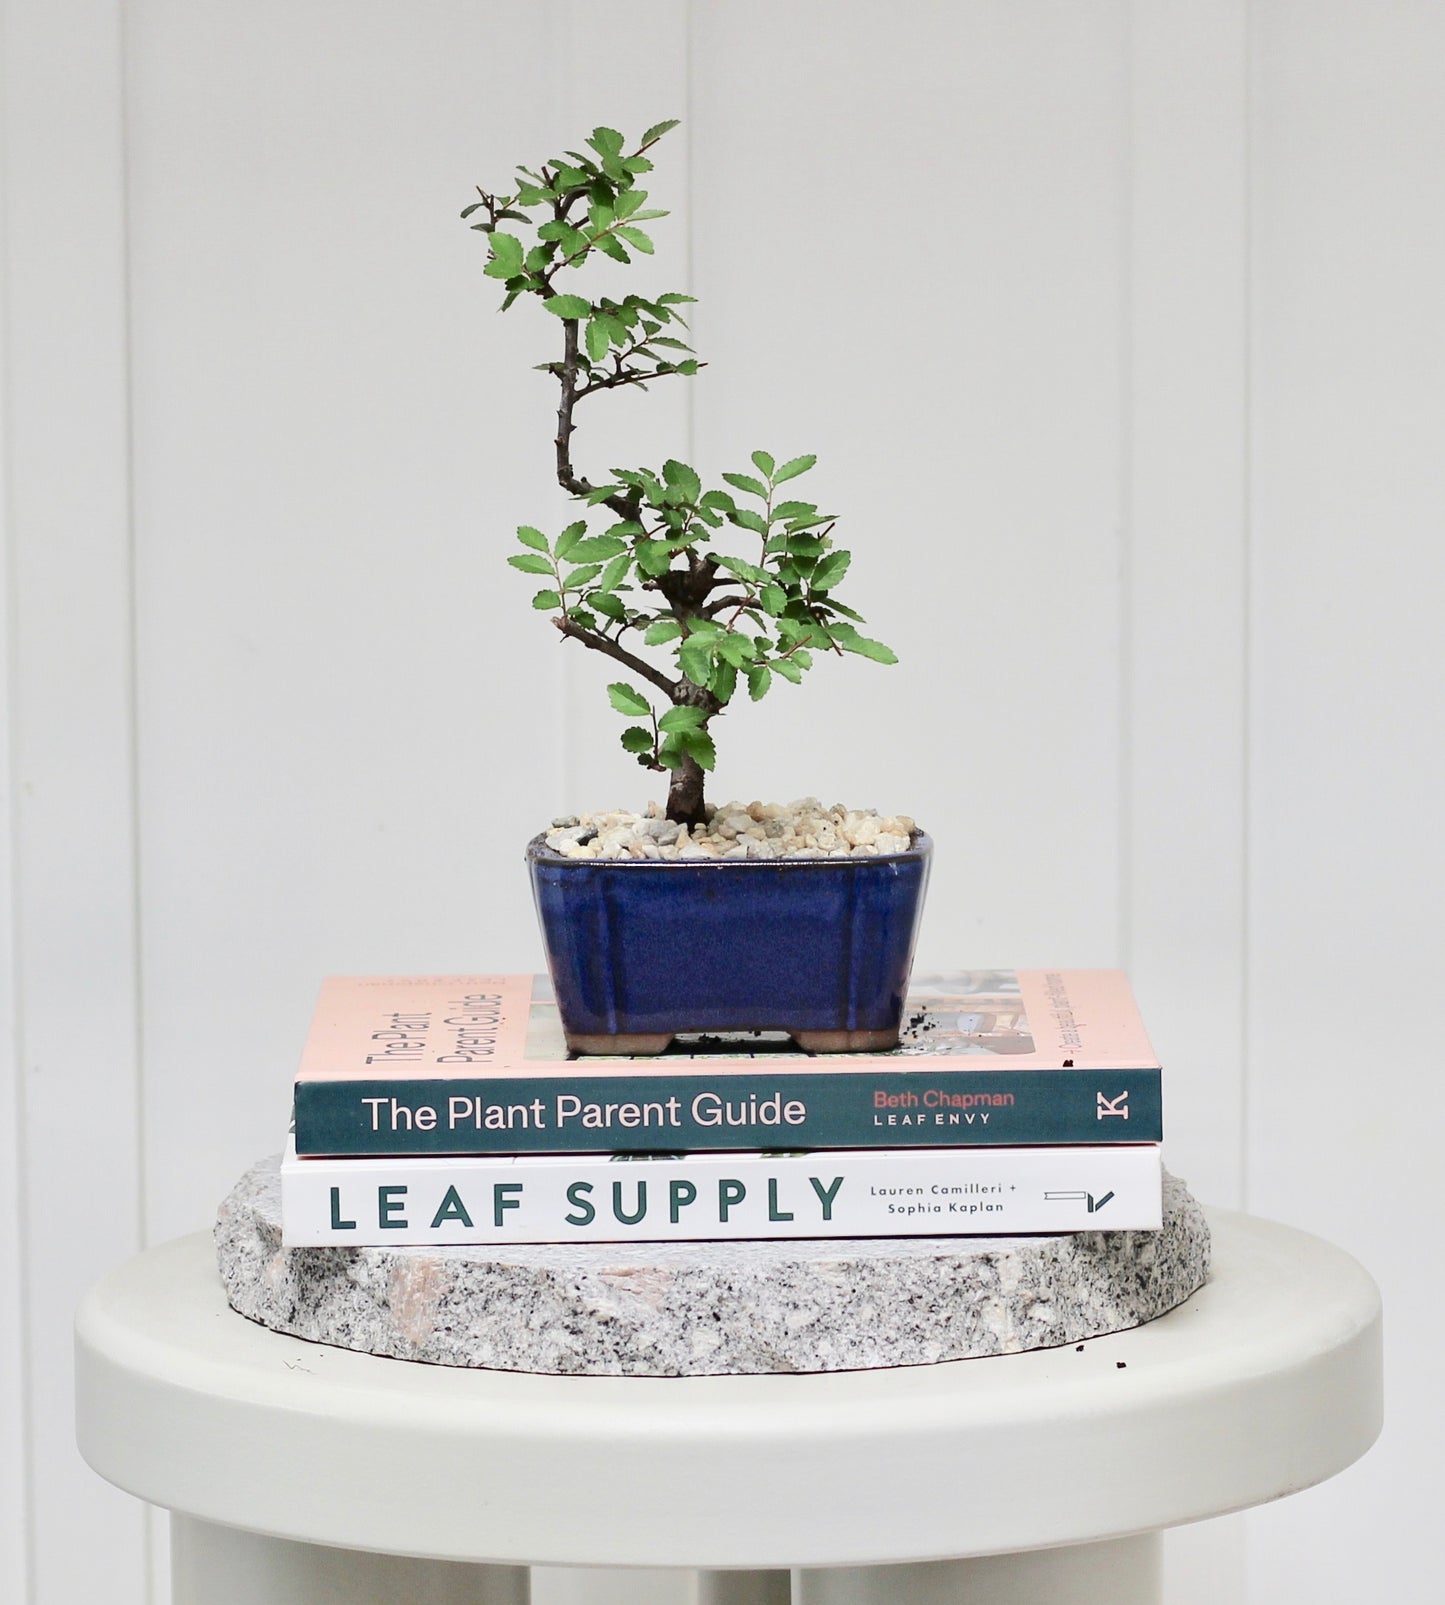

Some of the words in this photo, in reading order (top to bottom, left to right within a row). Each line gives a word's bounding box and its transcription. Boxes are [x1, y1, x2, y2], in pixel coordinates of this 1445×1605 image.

[443, 993, 503, 1026] Guide
[371, 1011, 432, 1040] Plant
[365, 1042, 426, 1064] The
[436, 1027, 499, 1063] Parent
[361, 1097, 437, 1131] The
[448, 1096, 546, 1130] Plant
[557, 1095, 682, 1128] Parent
[691, 1092, 806, 1126] Guide
[873, 1090, 918, 1108] Beth
[923, 1090, 1015, 1110] Chapman
[1096, 1090, 1129, 1121] K
[874, 1114, 926, 1126] LEAF
[935, 1113, 990, 1125] ENVY
[330, 1183, 524, 1230] LEAF
[565, 1178, 845, 1227] SUPPLY
[870, 1186, 924, 1196] Lauren
[931, 1184, 1002, 1195] Camilleri
[888, 1203, 942, 1216] Sophia
[948, 1201, 1004, 1215] Kaplan
